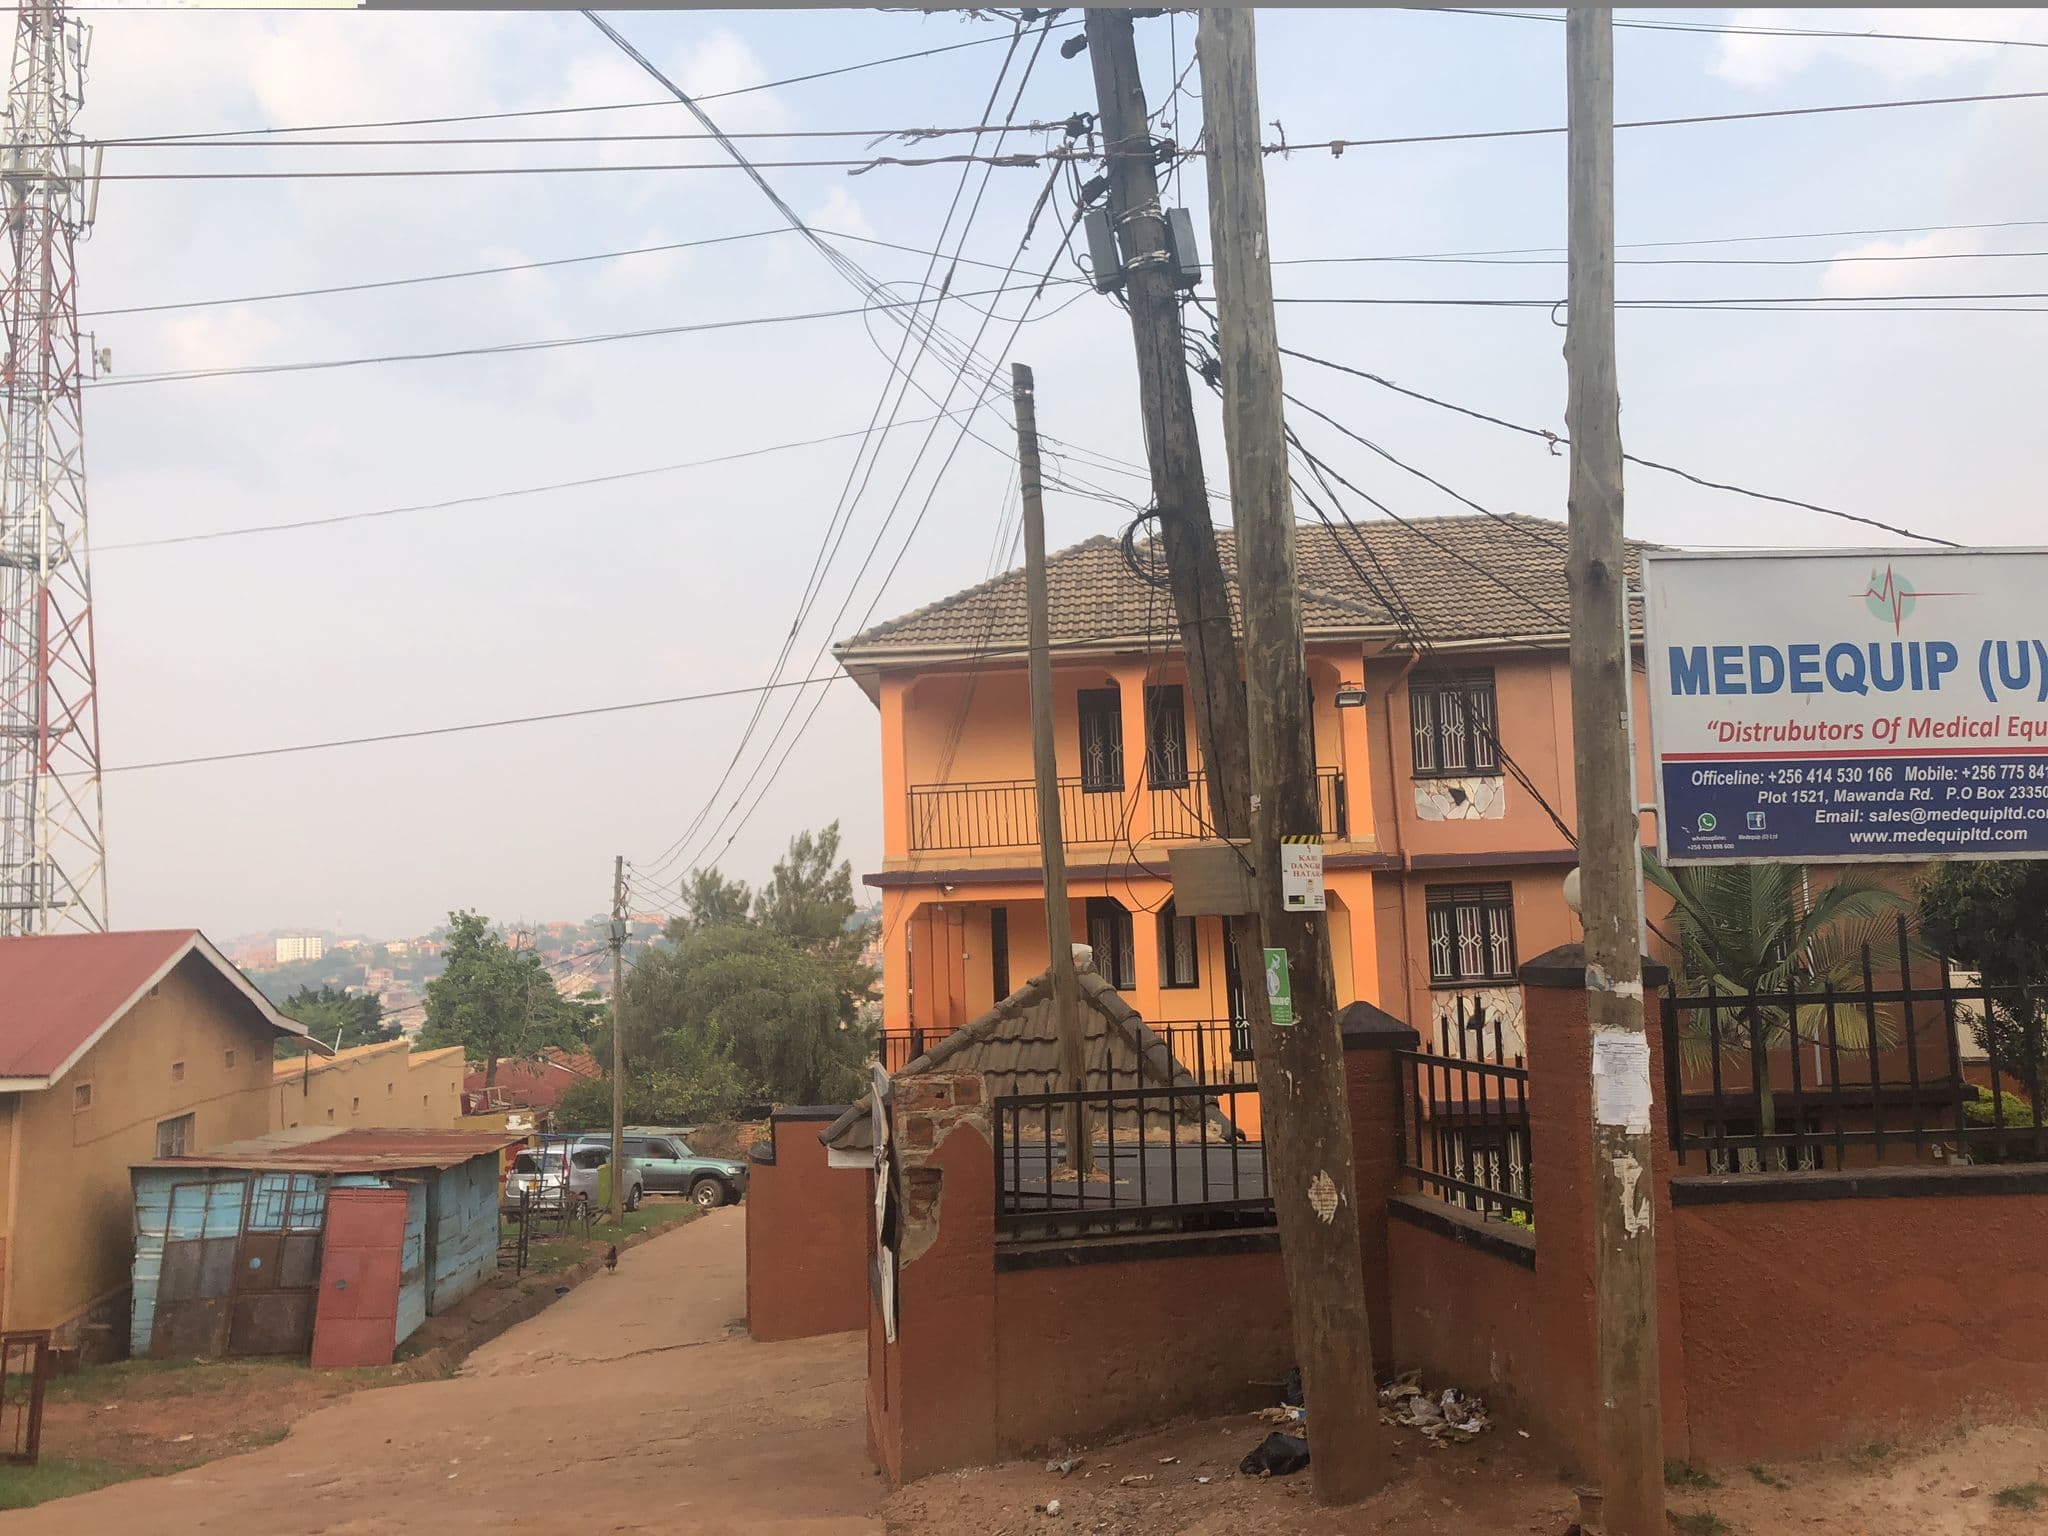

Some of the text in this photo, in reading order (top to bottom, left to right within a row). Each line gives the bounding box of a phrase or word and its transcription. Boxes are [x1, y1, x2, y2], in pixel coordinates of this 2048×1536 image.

[1668, 639, 2048, 703] MEDEQUIP (U)
[1871, 716, 1901, 744] Of
[1907, 714, 2000, 739] Medical
[1691, 770, 1764, 786] Officeline:
[1768, 768, 1803, 784] +256
[1806, 767, 1833, 783] 414
[1837, 767, 1863, 783] 530
[1867, 766, 1893, 782] 166
[1904, 765, 1958, 782] Mobile:
[1962, 764, 1996, 780] +256
[2000, 764, 2024, 780] 775
[1757, 790, 1787, 804] Plot
[1791, 789, 1829, 805] 1521,
[1833, 788, 1905, 803] Mawanda
[1909, 787, 1934, 801] Rd.
[1946, 786, 1973, 800] P.O
[1977, 785, 2005, 799] Box
[1815, 808, 1864, 823] Email:
[1849, 827, 2028, 845] www.medequipltd.com
